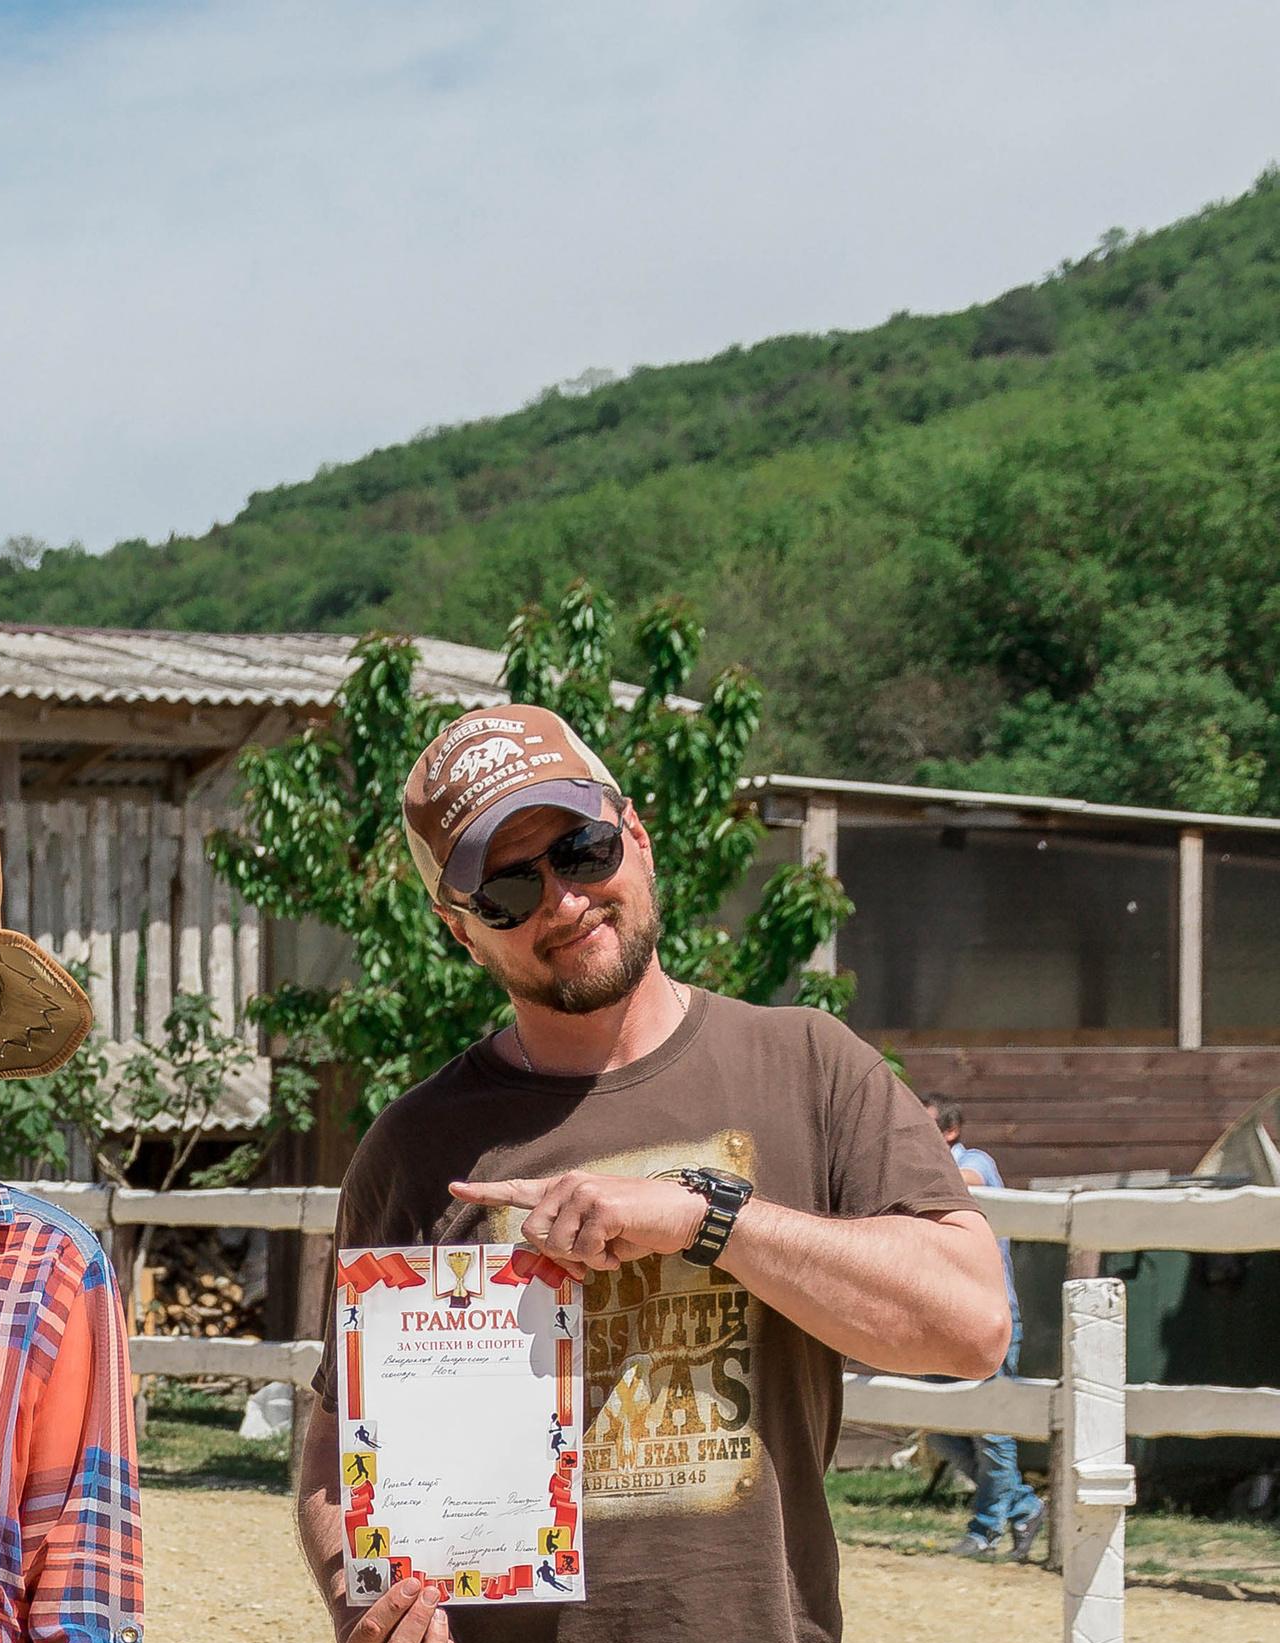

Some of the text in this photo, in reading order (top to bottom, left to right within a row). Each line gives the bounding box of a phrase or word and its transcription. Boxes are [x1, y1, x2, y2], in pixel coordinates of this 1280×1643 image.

[442, 720, 484, 753] STREET
[441, 759, 529, 829] CALIFORNIA
[529, 752, 563, 767] SUN
[401, 1309, 520, 1332] ГРАМОТА
[637, 1288, 749, 1350] WITH
[397, 1339, 525, 1352] ЗА УСПЕХИ В СПОРТЕ
[583, 1436, 752, 1473] NE STAR STATE
[583, 1470, 707, 1491] ABLISHED 1845
